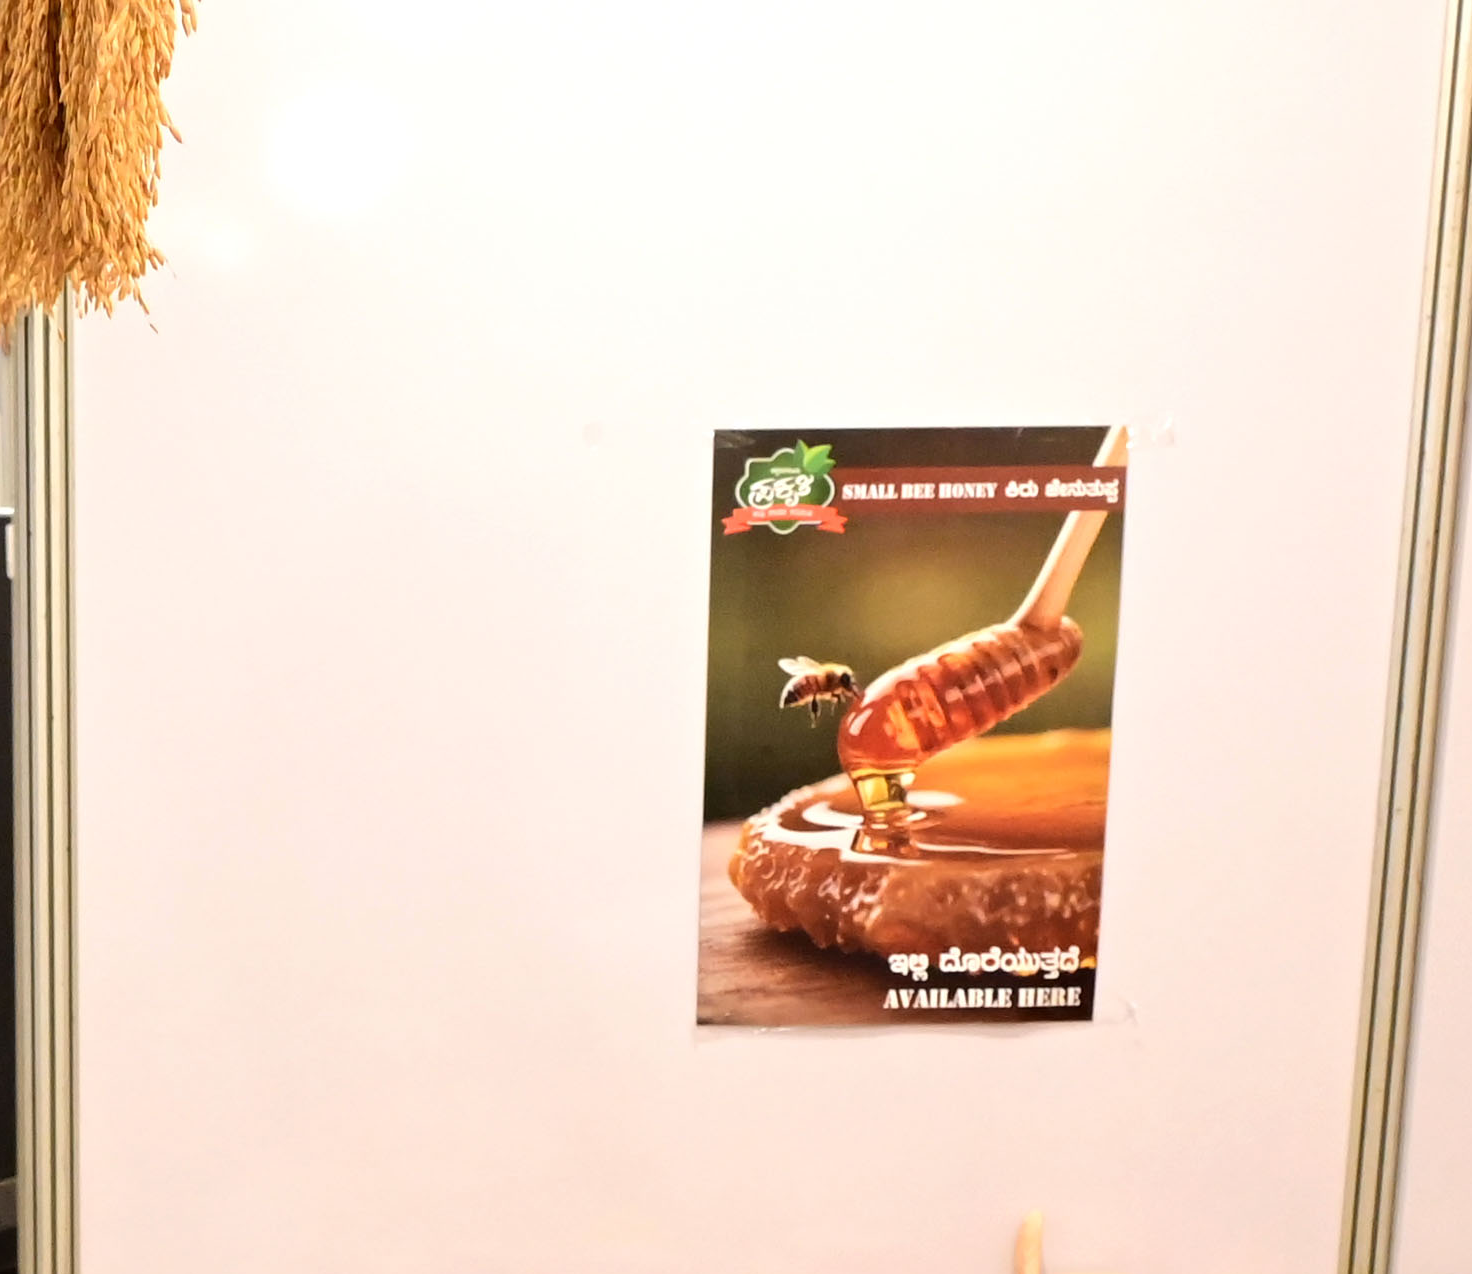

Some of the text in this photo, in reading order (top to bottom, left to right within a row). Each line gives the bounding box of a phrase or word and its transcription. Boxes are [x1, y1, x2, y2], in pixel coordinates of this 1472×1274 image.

[841, 482, 897, 501] SMALL
[900, 481, 935, 500] BEE
[938, 480, 998, 499] HONEY
[882, 986, 1082, 1010] AVAILABLE HERE
